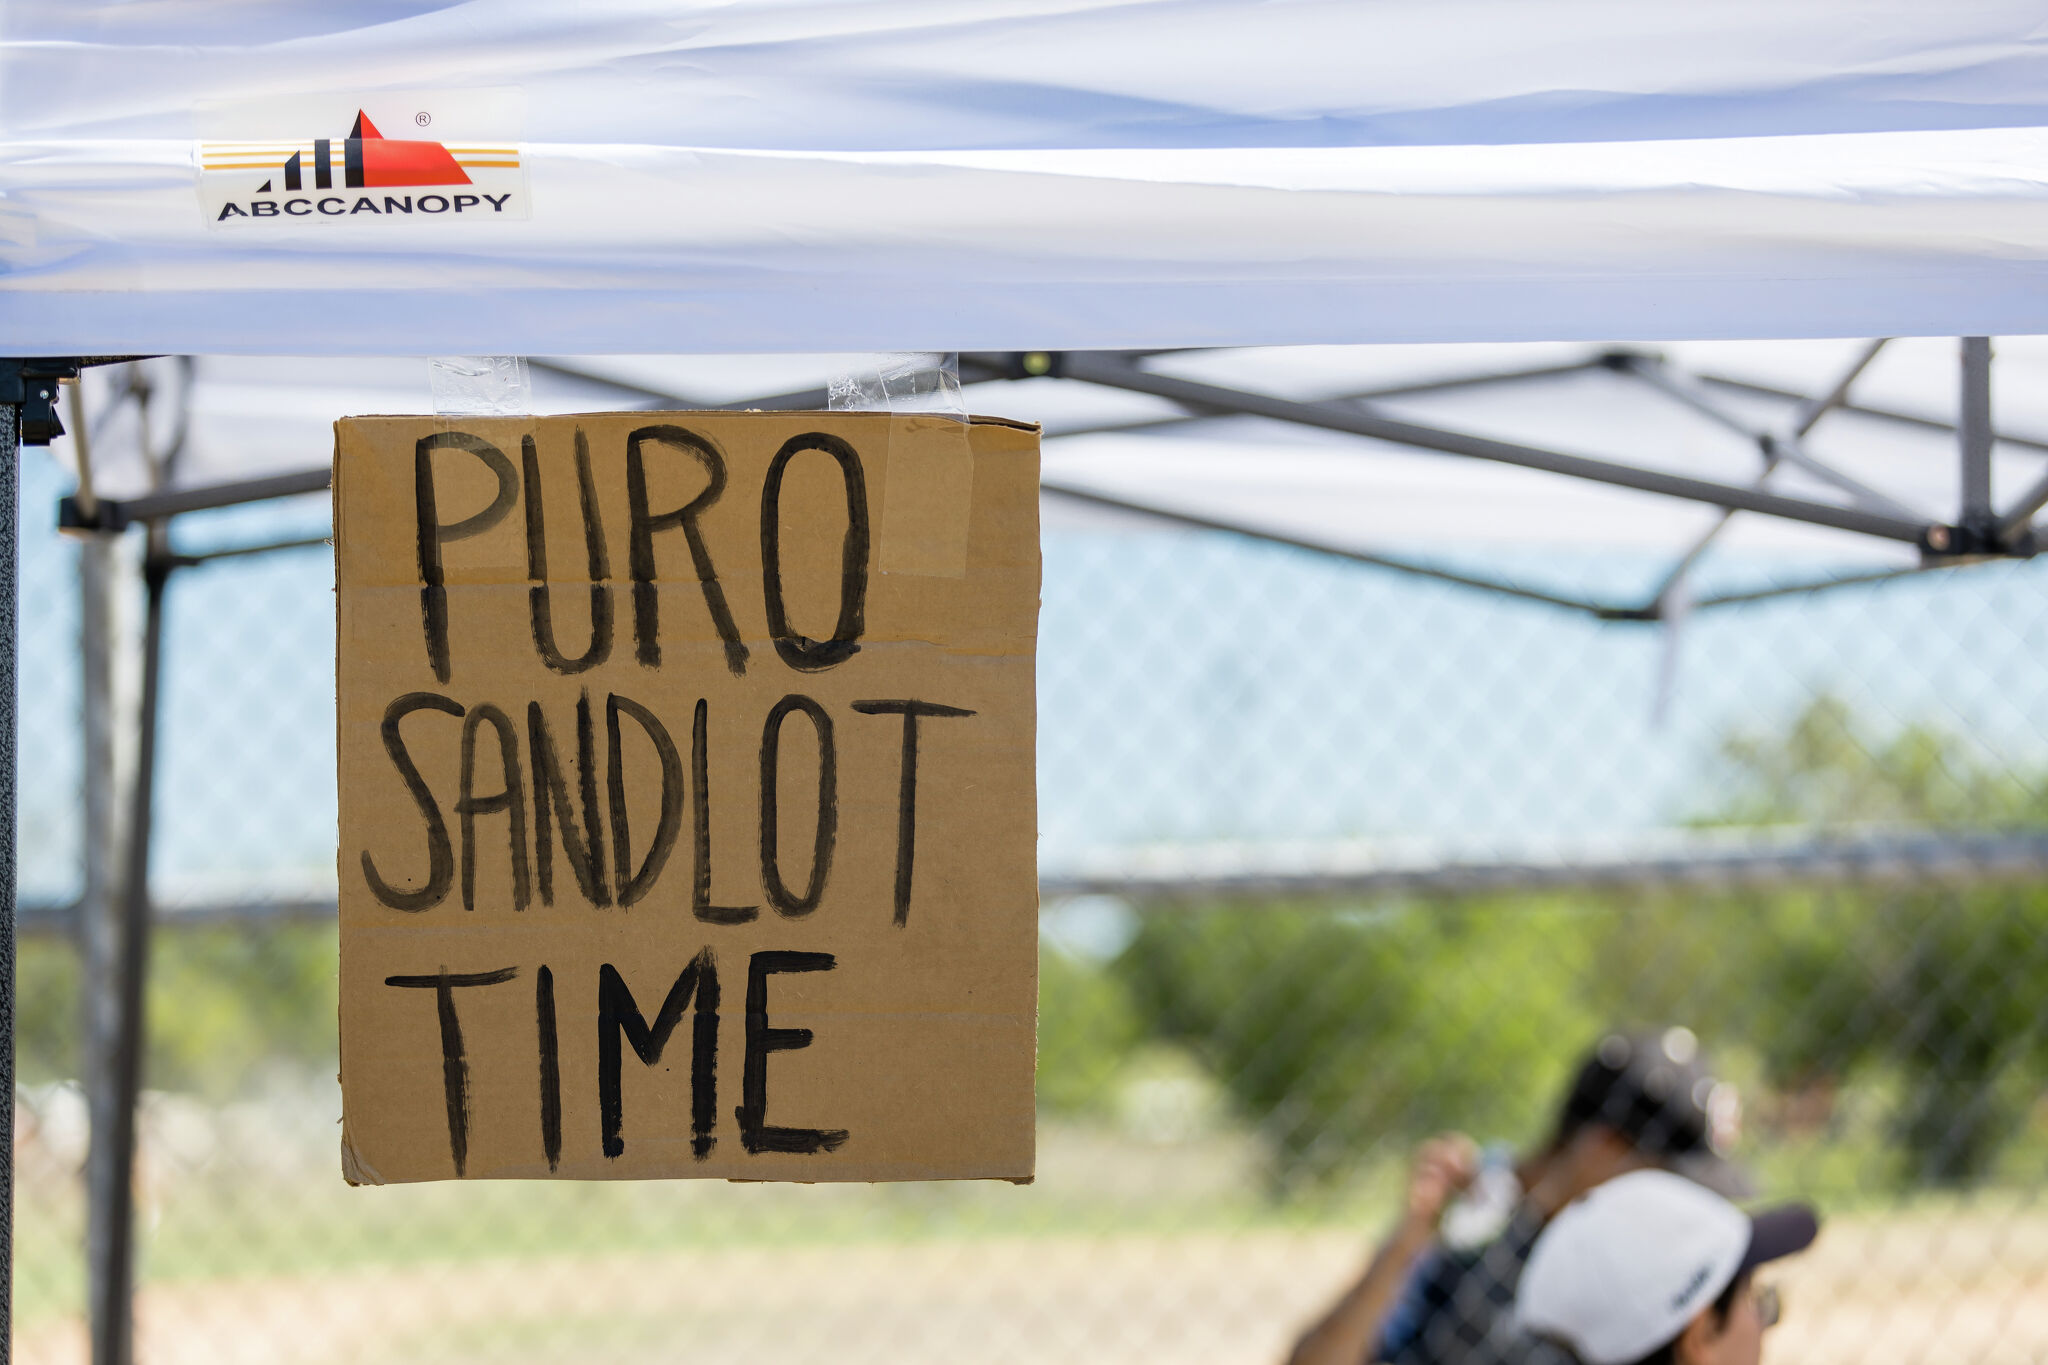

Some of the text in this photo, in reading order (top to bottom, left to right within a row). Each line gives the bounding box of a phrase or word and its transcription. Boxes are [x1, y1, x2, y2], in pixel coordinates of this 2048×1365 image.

[217, 193, 512, 222] ABCCANOPY
[415, 425, 871, 684] PURO
[361, 686, 979, 929] SANDLOT
[384, 945, 851, 1177] TIME
